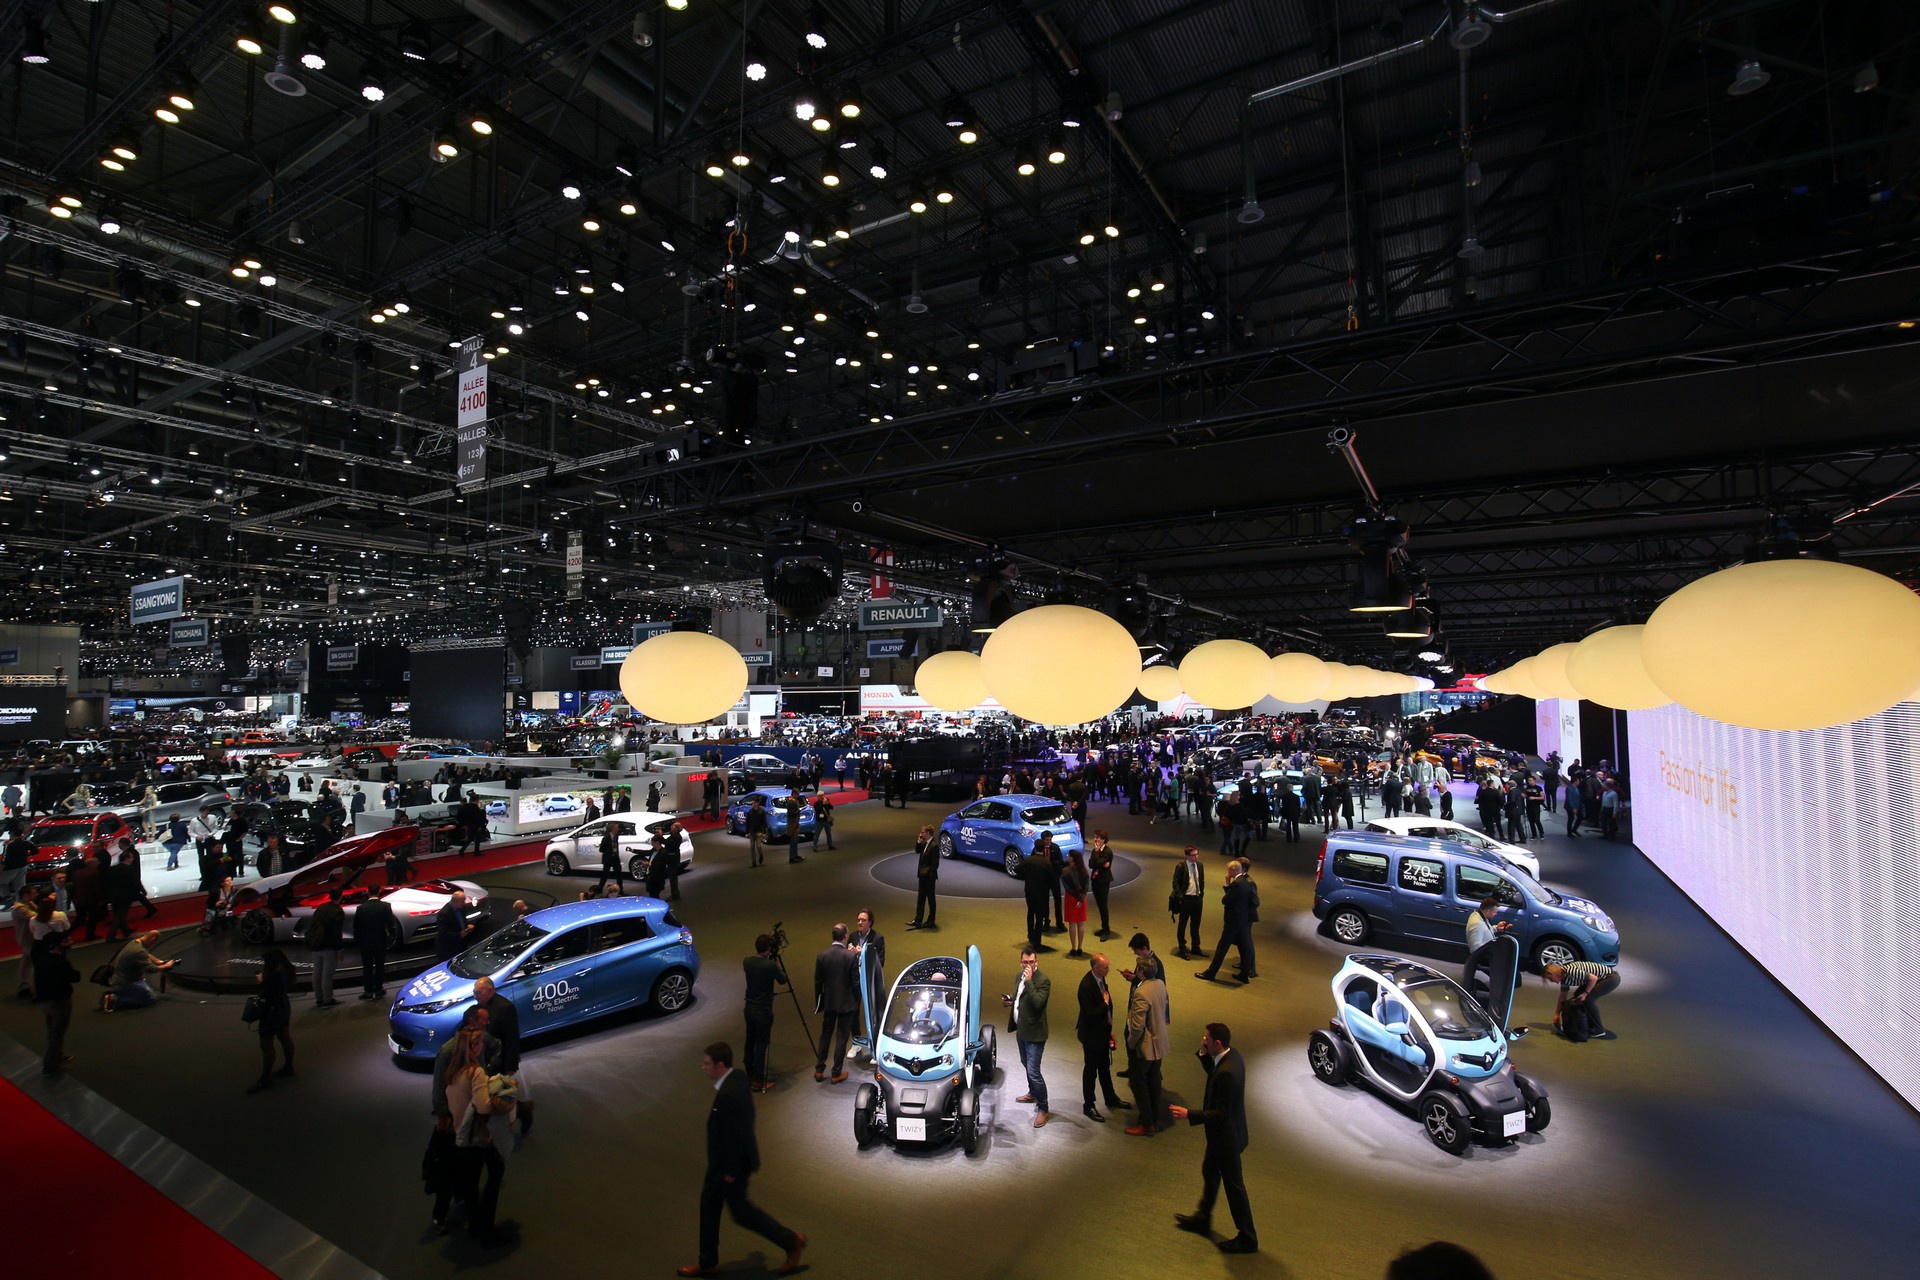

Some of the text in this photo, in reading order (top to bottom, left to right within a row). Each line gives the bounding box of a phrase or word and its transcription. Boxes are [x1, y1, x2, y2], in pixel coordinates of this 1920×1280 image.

[469, 351, 478, 369] 4
[463, 376, 485, 392] ALLÉE
[460, 390, 486, 413] 4100
[457, 426, 487, 444] HALLES
[567, 557, 582, 566] 4200
[134, 591, 176, 611] SSANGYONG
[870, 607, 930, 621] RENAULT
[174, 628, 203, 639] YOKOHAMA
[168, 754, 205, 762] YOKOHAMA
[845, 752, 889, 760] ALPNE
[688, 773, 708, 782] ISUZ
[1659, 750, 1739, 819] Passion for life
[533, 993, 580, 1012] 100% Electric.
[547, 1004, 566, 1013] Now.
[900, 1125, 923, 1133] TWIZY
[1506, 1118, 1524, 1128] TWIZY
